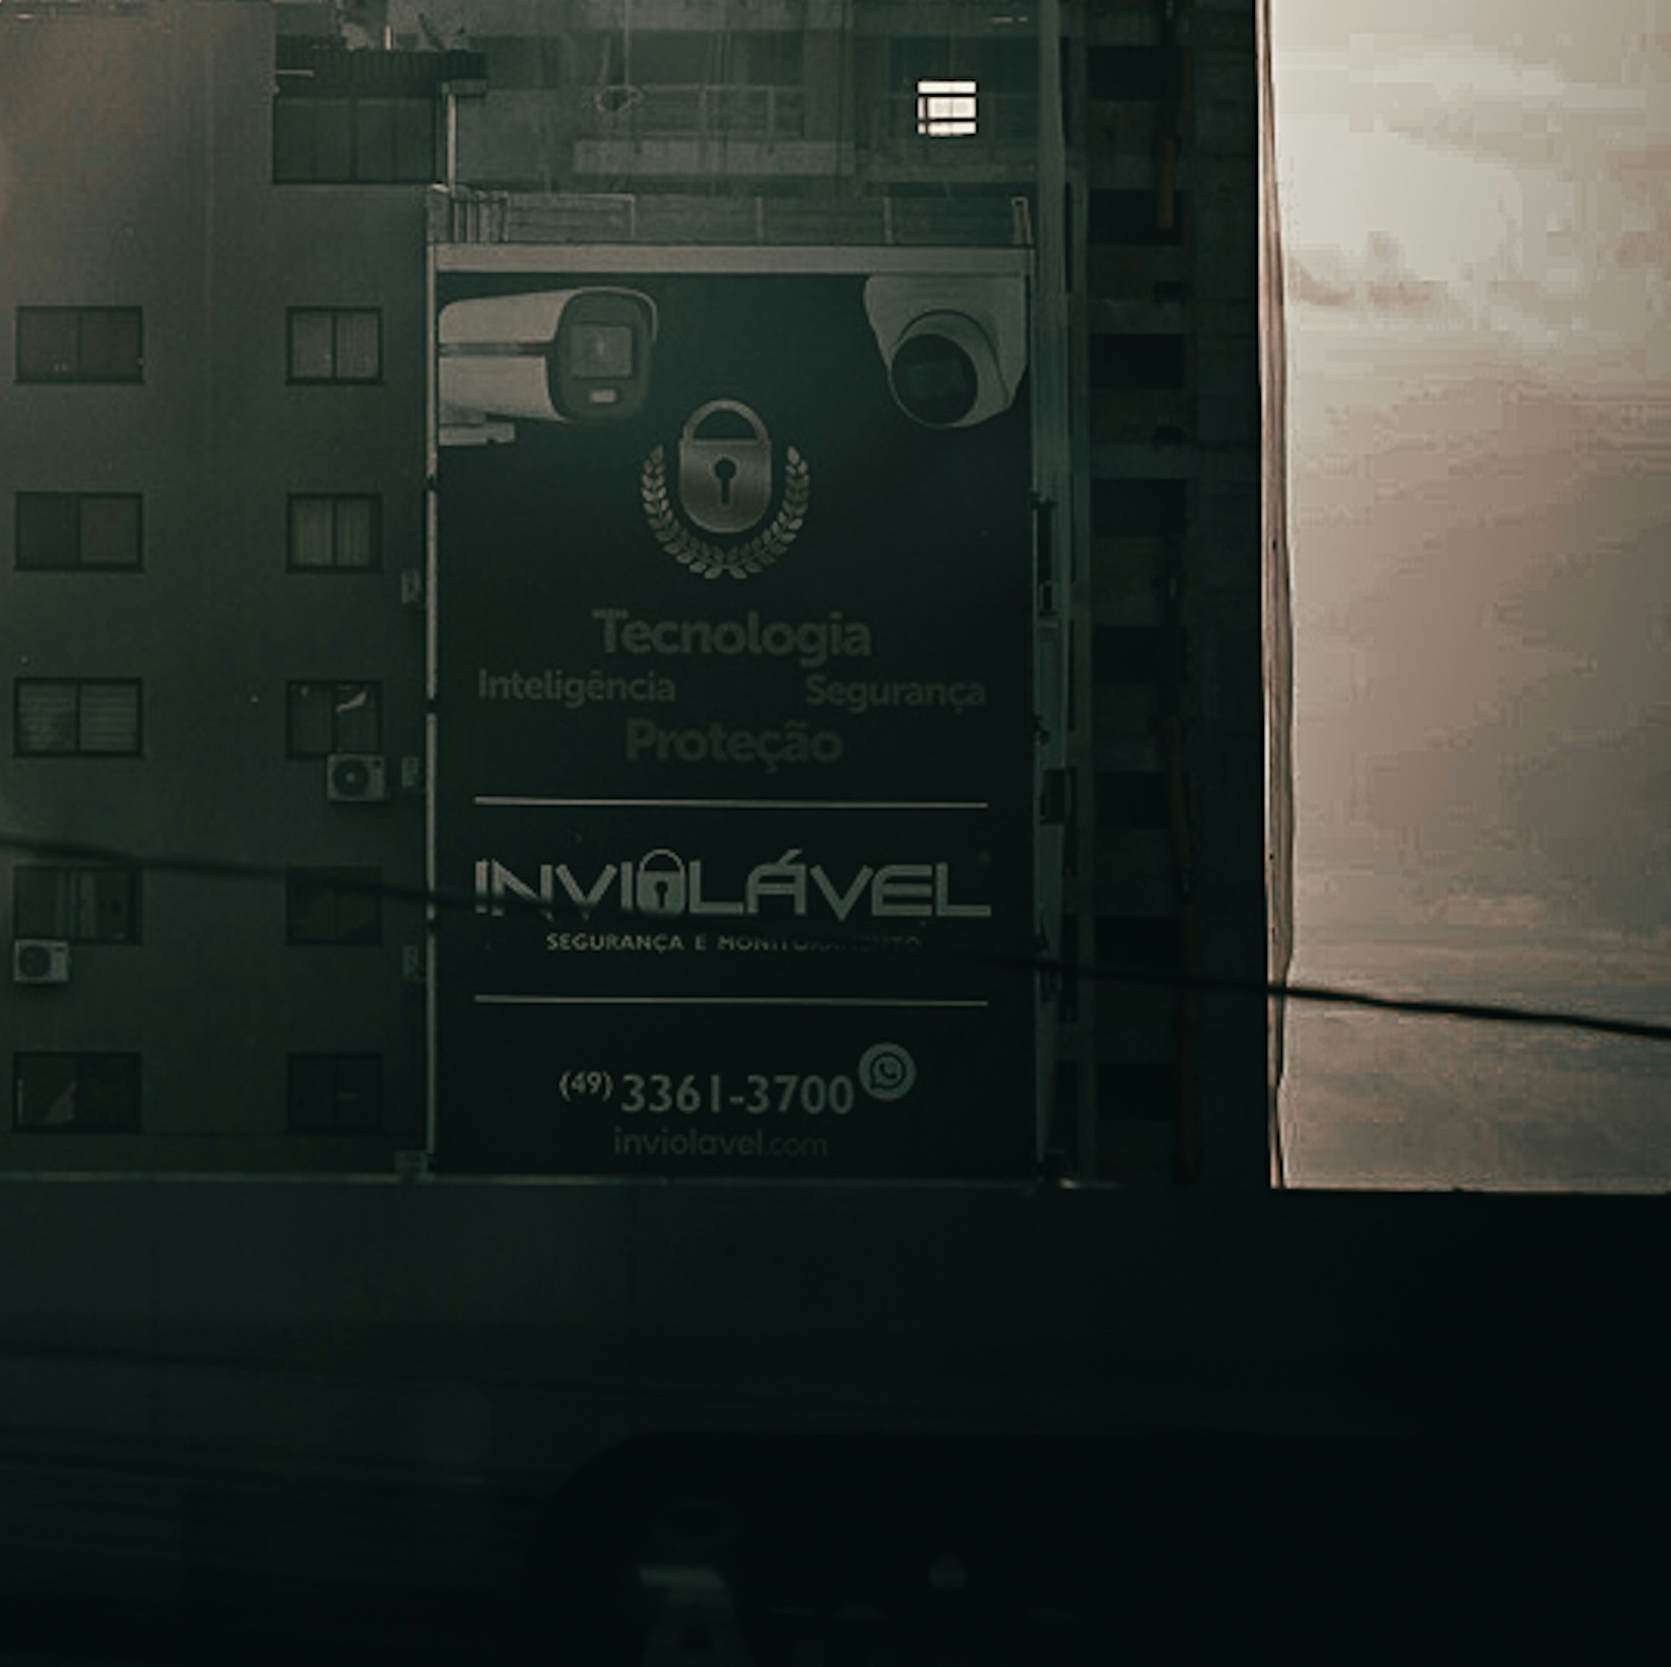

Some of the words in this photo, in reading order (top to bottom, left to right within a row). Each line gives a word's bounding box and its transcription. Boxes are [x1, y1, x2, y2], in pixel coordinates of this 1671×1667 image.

[592, 608, 871, 666] Tecnologia
[477, 670, 676, 709] Inteligência
[806, 674, 986, 713] Segurança
[628, 718, 844, 772] Proteção
[474, 848, 992, 921] INVIOLÁVEL
[545, 933, 685, 954] SEGURANÇA
[695, 935, 707, 951] E
[558, 1071, 614, 1102] (49)
[620, 1074, 855, 1115] 3361-3700
[613, 1126, 828, 1157] inviolavel.com
